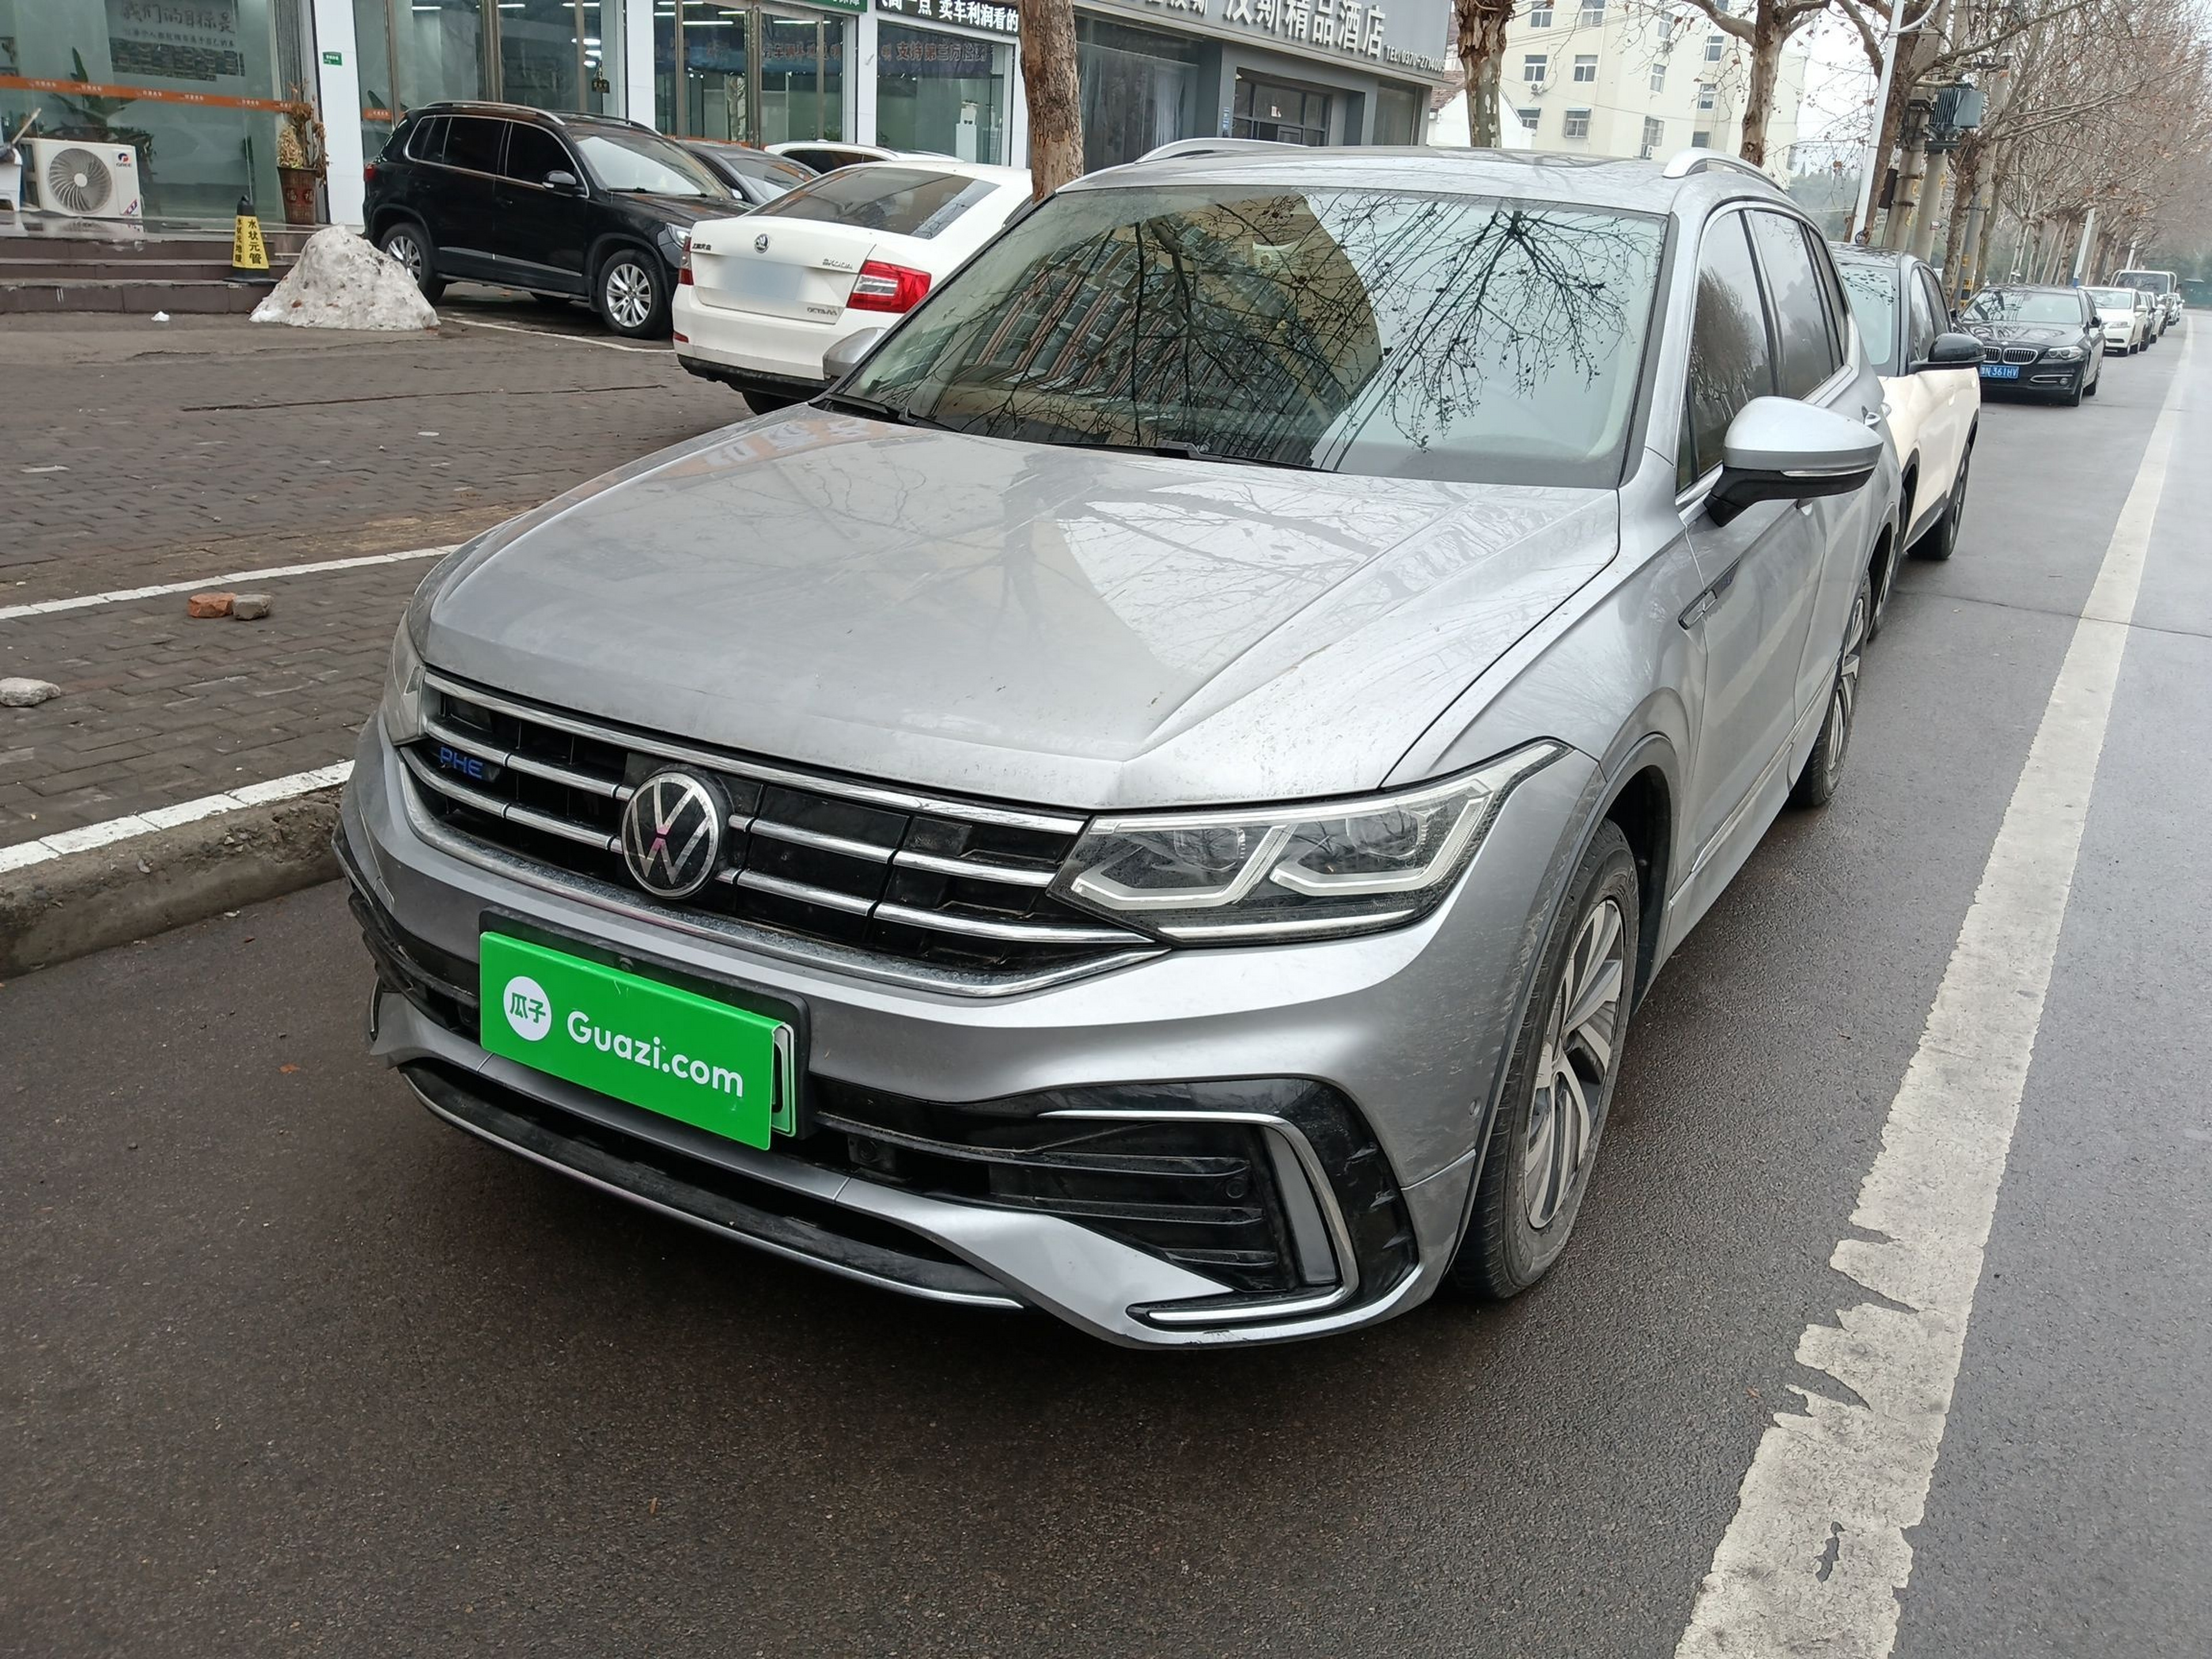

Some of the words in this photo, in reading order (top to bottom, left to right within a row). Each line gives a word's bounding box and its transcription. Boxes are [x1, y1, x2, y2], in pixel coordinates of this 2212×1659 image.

[939, 1, 1019, 32] 卖车利润看的
[247, 219, 262, 264] 水状元管
[510, 992, 546, 1024] 瓜子
[566, 1010, 744, 1098] Guazi.com
